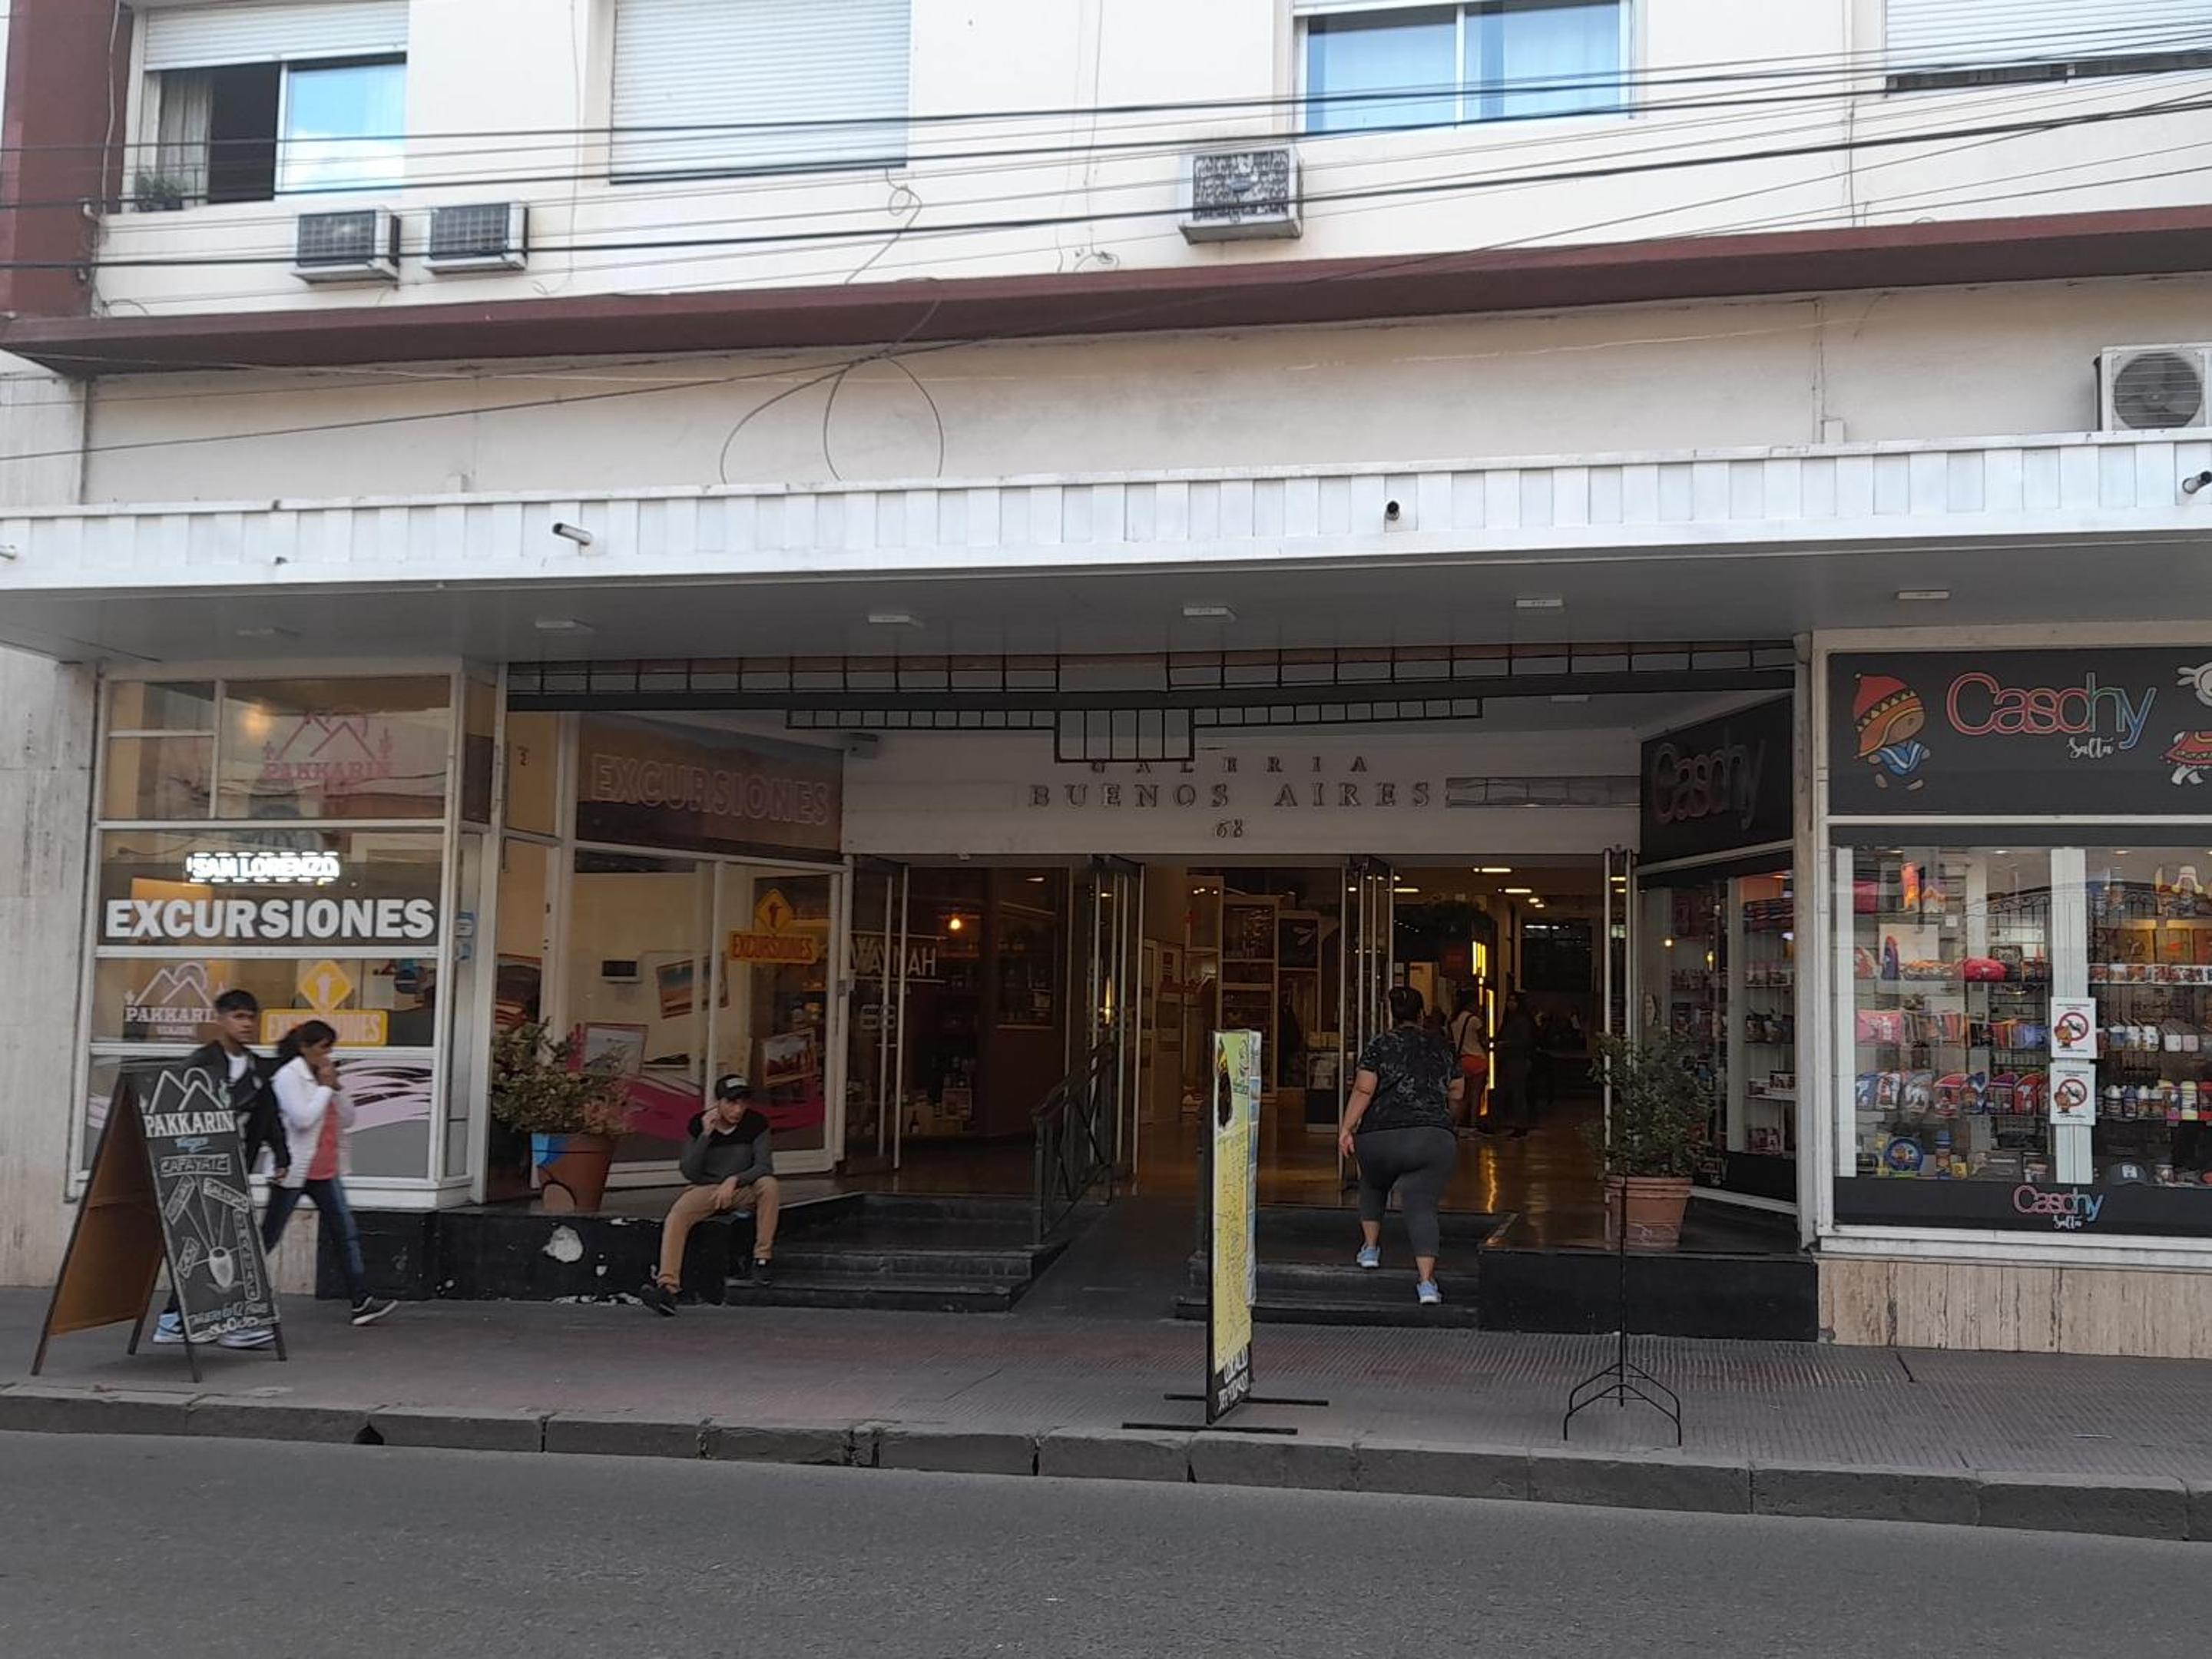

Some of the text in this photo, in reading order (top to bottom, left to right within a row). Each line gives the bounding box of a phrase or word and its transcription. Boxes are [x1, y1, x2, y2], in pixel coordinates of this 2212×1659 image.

[2067, 736, 2114, 759] Salta
[590, 753, 830, 827] EXCURSIONES
[1028, 782, 1432, 808] BUENOS AIRES
[1214, 819, 1243, 839] 68
[192, 856, 237, 877] SAN
[104, 898, 436, 939] EXCURSIONES
[125, 1007, 218, 1023] PAKKARI
[143, 1110, 237, 1138] PAKKARIN
[160, 1154, 229, 1174] CAFAYATE
